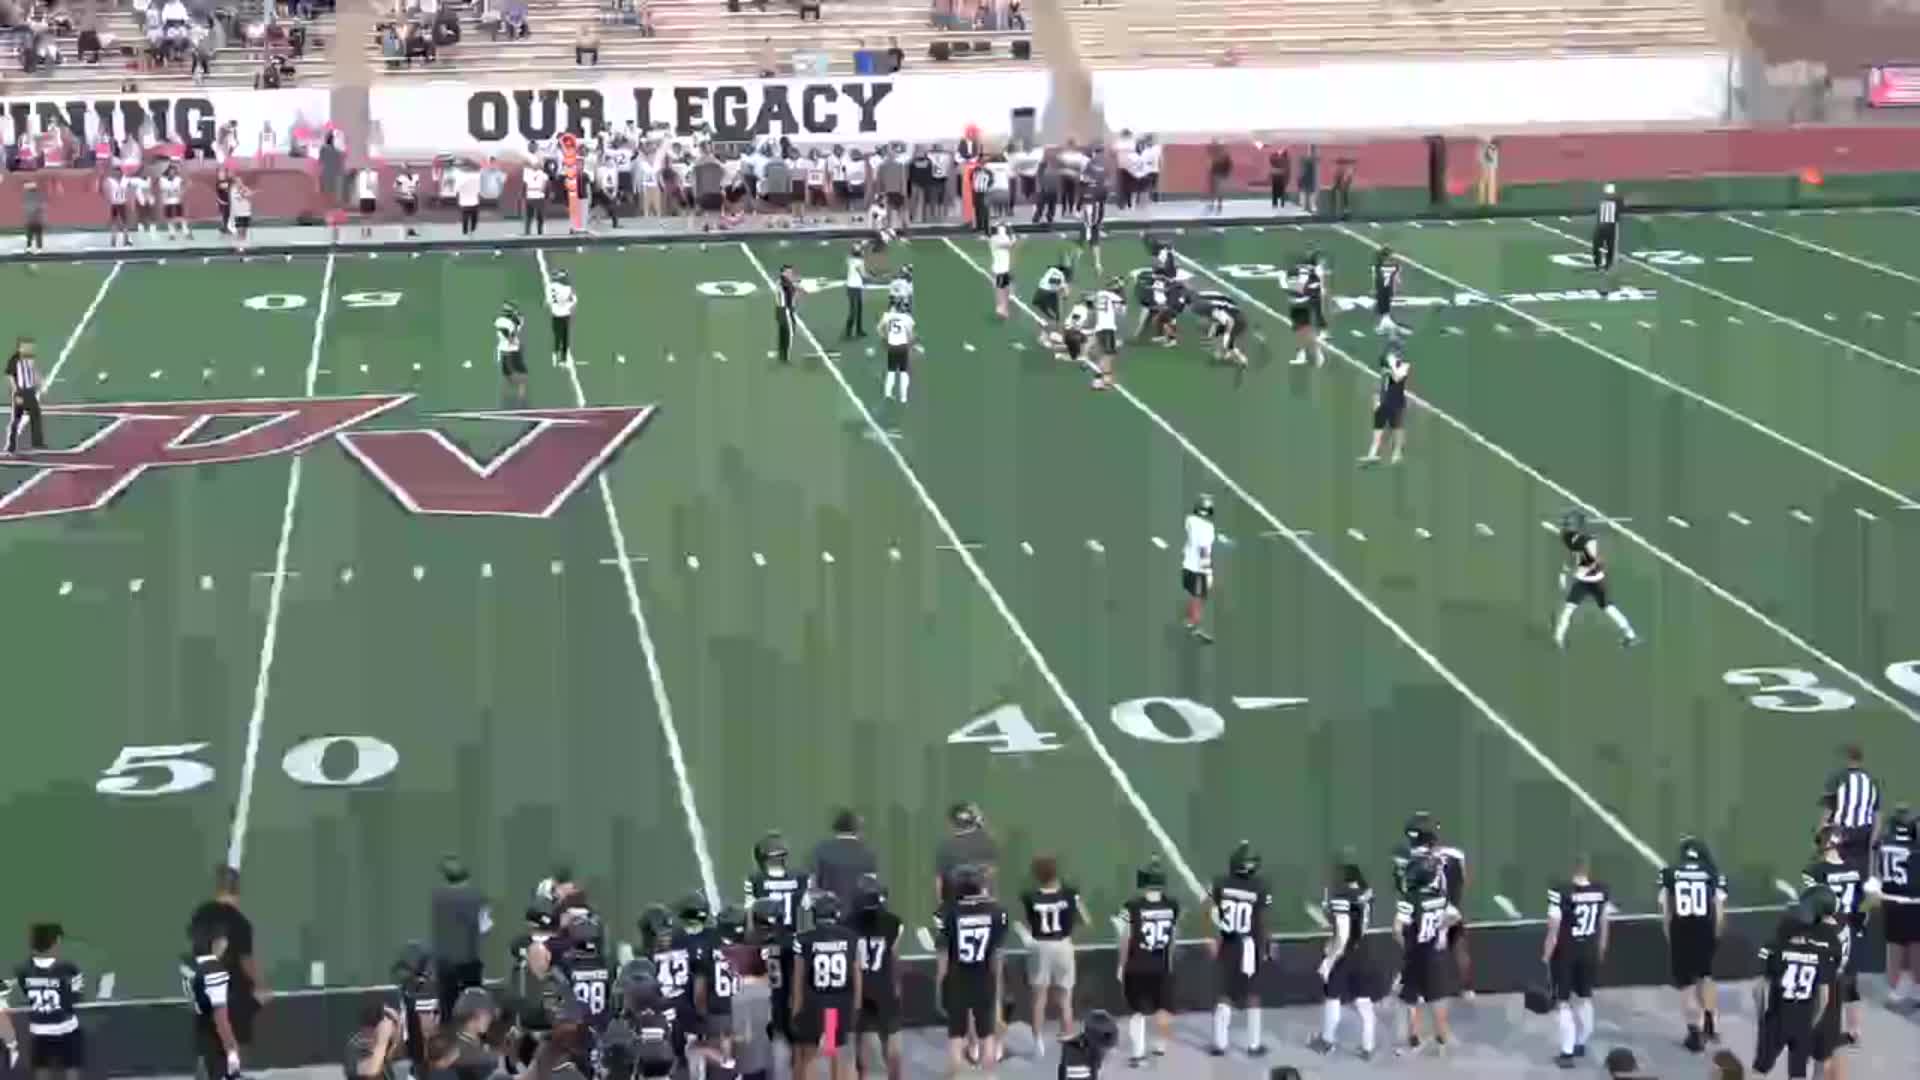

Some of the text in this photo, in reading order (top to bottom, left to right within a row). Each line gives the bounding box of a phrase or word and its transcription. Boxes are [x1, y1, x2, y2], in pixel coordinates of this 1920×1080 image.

[467, 82, 893, 143] OUR LEGACY
[1221, 899, 1252, 934] 30
[1675, 881, 1707, 917] 60
[1140, 920, 1172, 951] 35
[1571, 903, 1598, 937] 31
[957, 927, 990, 963] 57
[813, 953, 847, 988] 89
[1781, 963, 1817, 1000] 49
